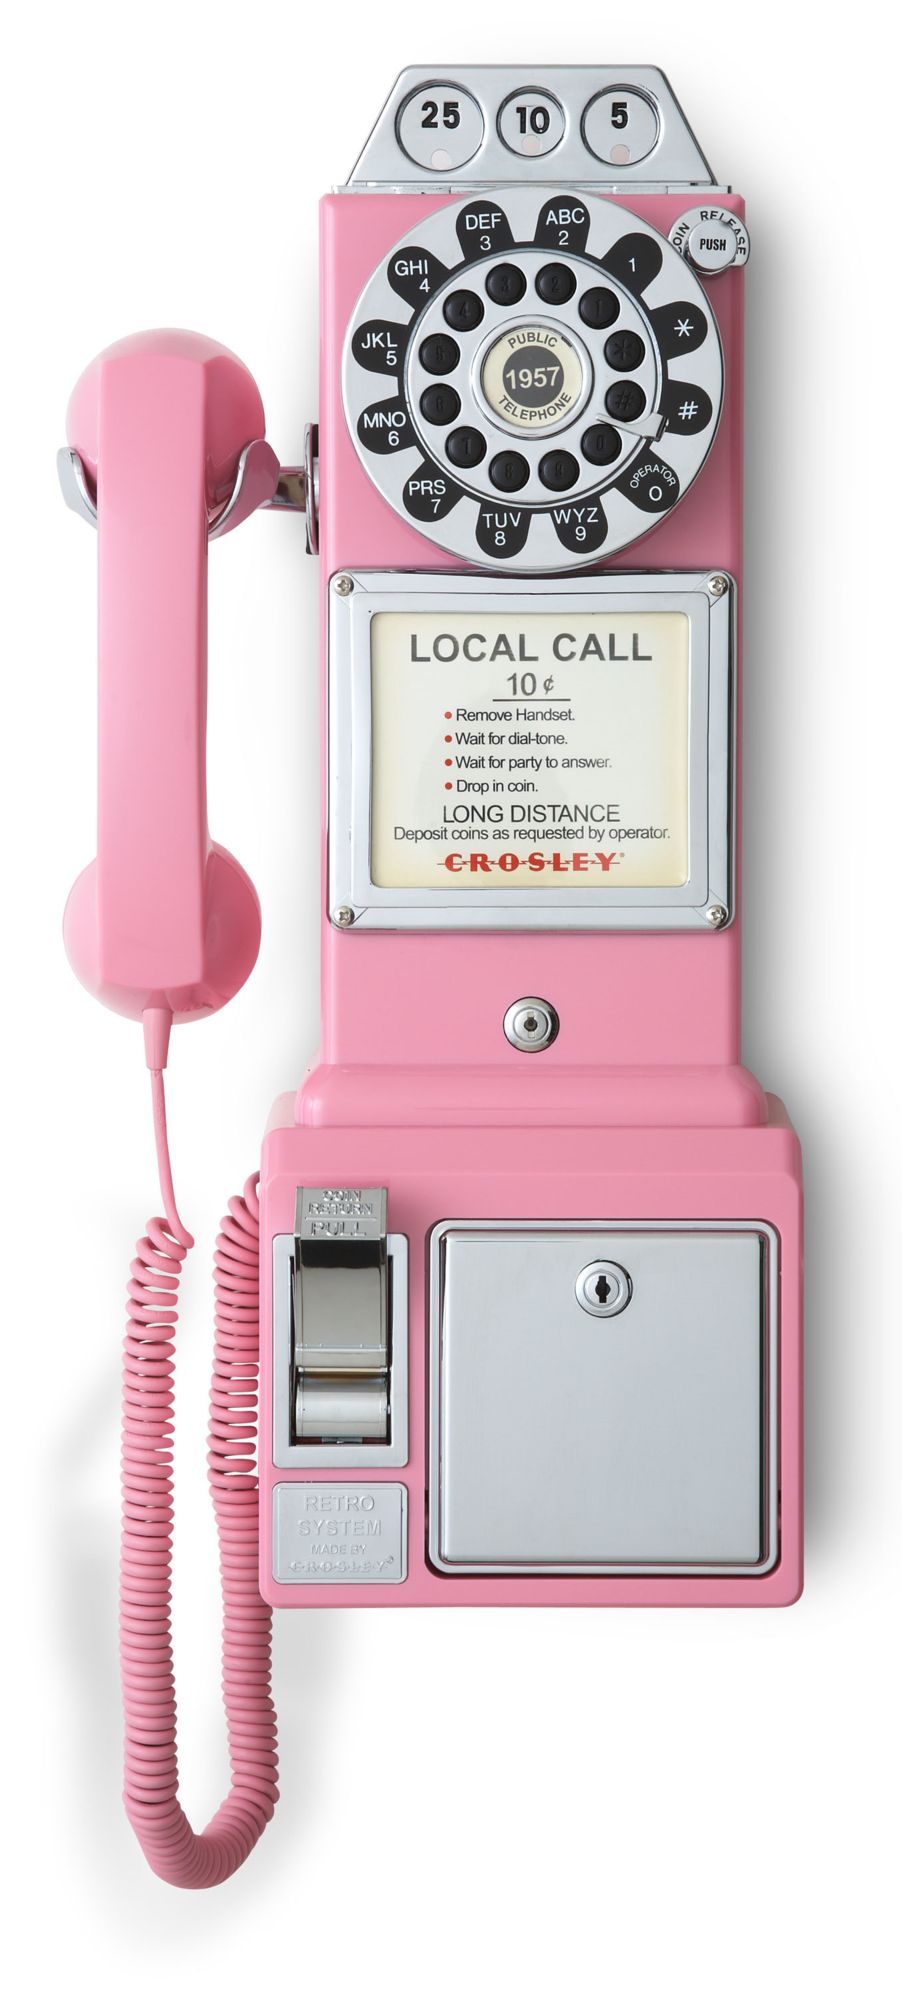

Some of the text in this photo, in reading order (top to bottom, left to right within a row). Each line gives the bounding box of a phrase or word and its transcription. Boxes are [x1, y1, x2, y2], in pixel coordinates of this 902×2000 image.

[421, 101, 460, 129] 25
[516, 106, 550, 134] 10
[611, 102, 628, 129] 5
[466, 213, 501, 230] DEF
[546, 206, 587, 225] ABC
[480, 236, 491, 250] 3
[559, 231, 568, 245] 2
[700, 239, 726, 251] PUSH
[395, 260, 428, 276] GHI
[629, 258, 635, 272] 1
[420, 278, 430, 292] 4
[550, 276, 561, 293] 2
[362, 332, 397, 348] JKL
[507, 331, 558, 349] PUBLIC
[387, 351, 397, 365] 5
[505, 365, 561, 390] 1957
[498, 392, 572, 421] TELEPHONE
[678, 401, 698, 419] #
[362, 410, 406, 428] MNO
[389, 431, 399, 446] 6
[629, 464, 677, 489] OPERATOR
[407, 478, 446, 496] PRS
[431, 499, 441, 513] 7
[482, 512, 521, 528] TUV
[552, 506, 598, 525] WYZ
[495, 531, 505, 545] 8
[576, 526, 586, 541] 9
[411, 633, 652, 662] LOCAL CALL
[507, 673, 536, 696] 10
[457, 708, 575, 721] Remove Handset.
[455, 732, 567, 745] Wait for dial-tone.
[456, 756, 611, 771] Wait for party to answer.
[457, 779, 538, 795] Drop in coin.
[444, 805, 620, 823] LONG DISTANCE
[394, 826, 670, 843] Deposit coins as requested by operator.
[322, 1189, 362, 1202] COIN
[308, 1202, 374, 1215] RETURN
[310, 1221, 367, 1237] PULL
[305, 1495, 375, 1512] RETRO
[298, 1519, 382, 1537] SYSTEM
[311, 1543, 368, 1555] MADE BY
